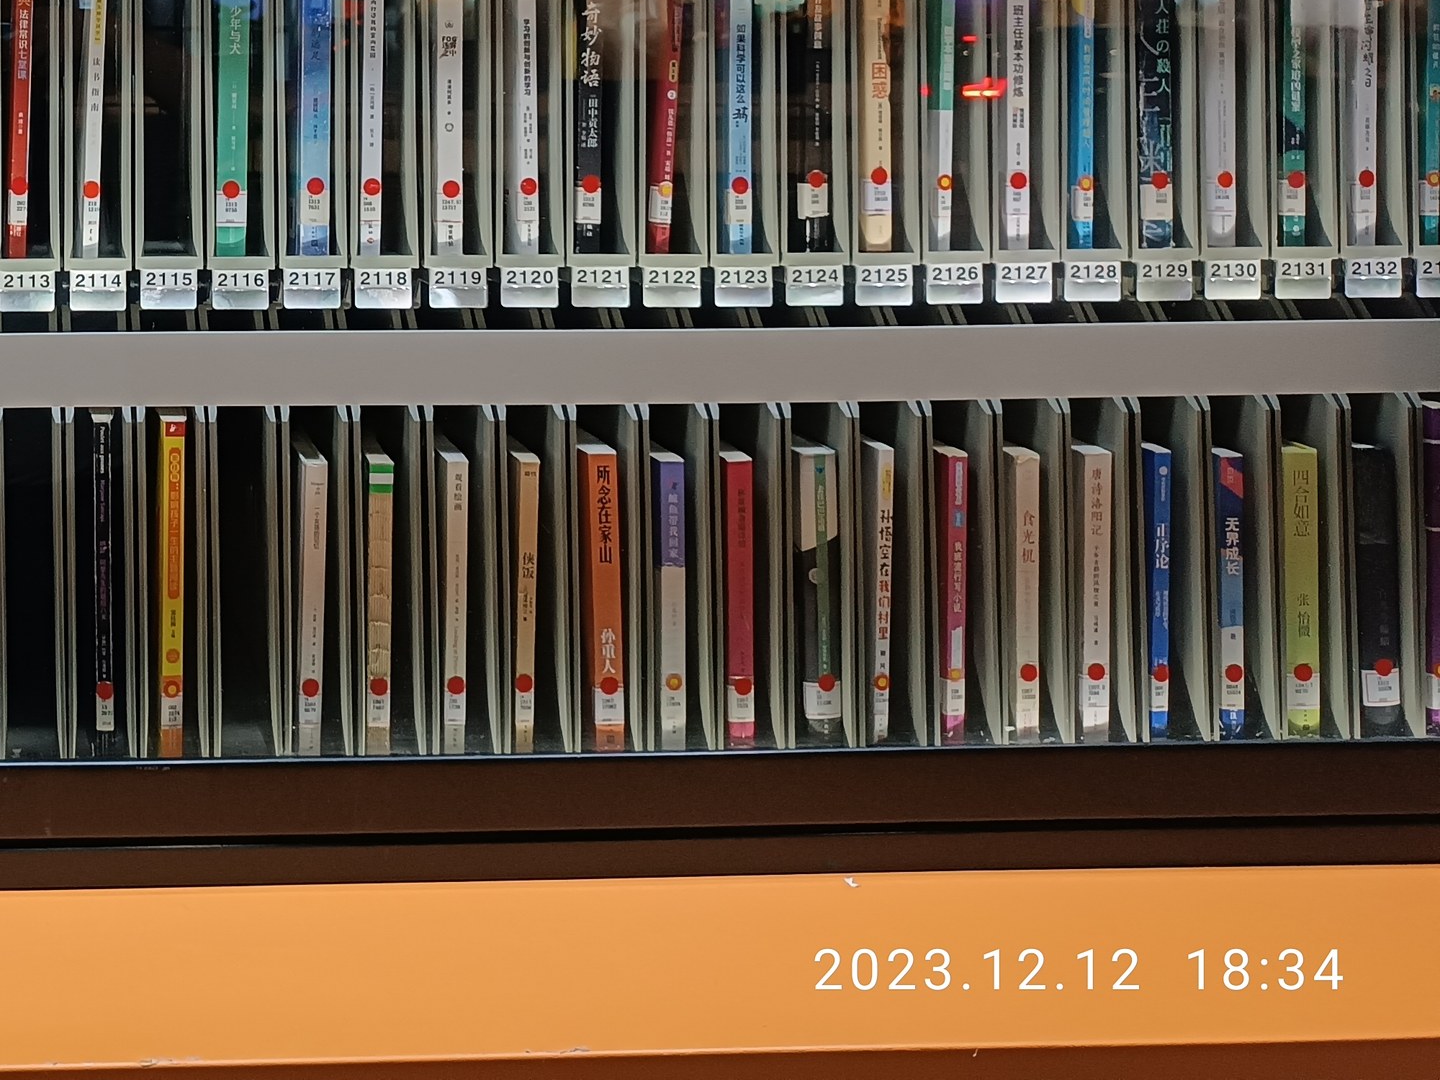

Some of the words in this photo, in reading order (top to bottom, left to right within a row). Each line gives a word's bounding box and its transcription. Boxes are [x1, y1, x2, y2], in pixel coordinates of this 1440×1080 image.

[228, 5, 241, 55] 少年与犬
[18, 9, 31, 81] 法律常识七堂课
[1012, 4, 1025, 98] 班主任基本功修炼
[871, 62, 888, 99] 困惑
[932, 266, 979, 281] 2126
[1001, 265, 1047, 281] 2127
[1070, 264, 1117, 280] 2128
[1142, 263, 1188, 278] 2129
[1211, 263, 1257, 278] 2130
[1281, 262, 1325, 276] 2131
[1351, 261, 1397, 275] 2132
[3, 274, 50, 288] 2113
[75, 273, 122, 288] 2114
[146, 272, 192, 287] 2115
[217, 273, 264, 287] 2116
[289, 271, 336, 286] 2117
[360, 271, 407, 286] 2118
[434, 270, 482, 285] 2119
[506, 270, 554, 285] 2120
[577, 269, 622, 284] 2121
[648, 270, 696, 285] 2122
[720, 269, 768, 284] 2123
[792, 268, 839, 284] 2124
[861, 268, 908, 284] 2125
[1092, 467, 1104, 537] 唐诗洛阳记
[1293, 469, 1309, 538] 四合如意
[596, 465, 612, 564] 所念在家山
[1023, 509, 1036, 563] 食光机
[1224, 517, 1240, 576] 无界成长
[522, 552, 535, 580] 侠饭
[878, 508, 893, 640] 孙悟空在我们村里
